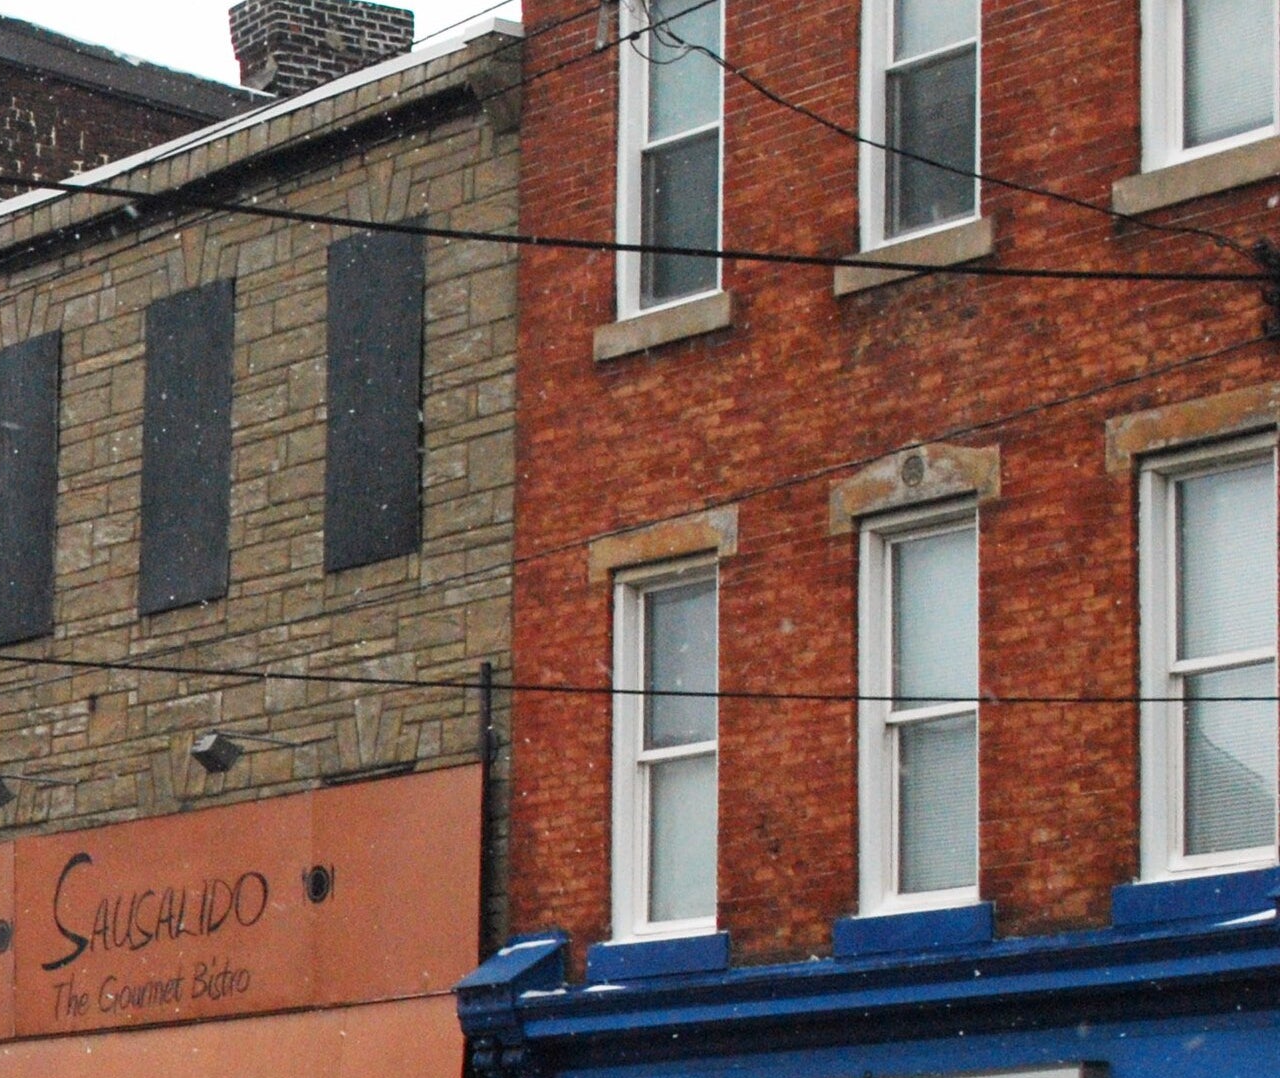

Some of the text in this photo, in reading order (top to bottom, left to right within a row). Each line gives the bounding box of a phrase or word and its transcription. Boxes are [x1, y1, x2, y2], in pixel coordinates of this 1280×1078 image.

[53, 956, 251, 1018] The Gourmet Bistro
